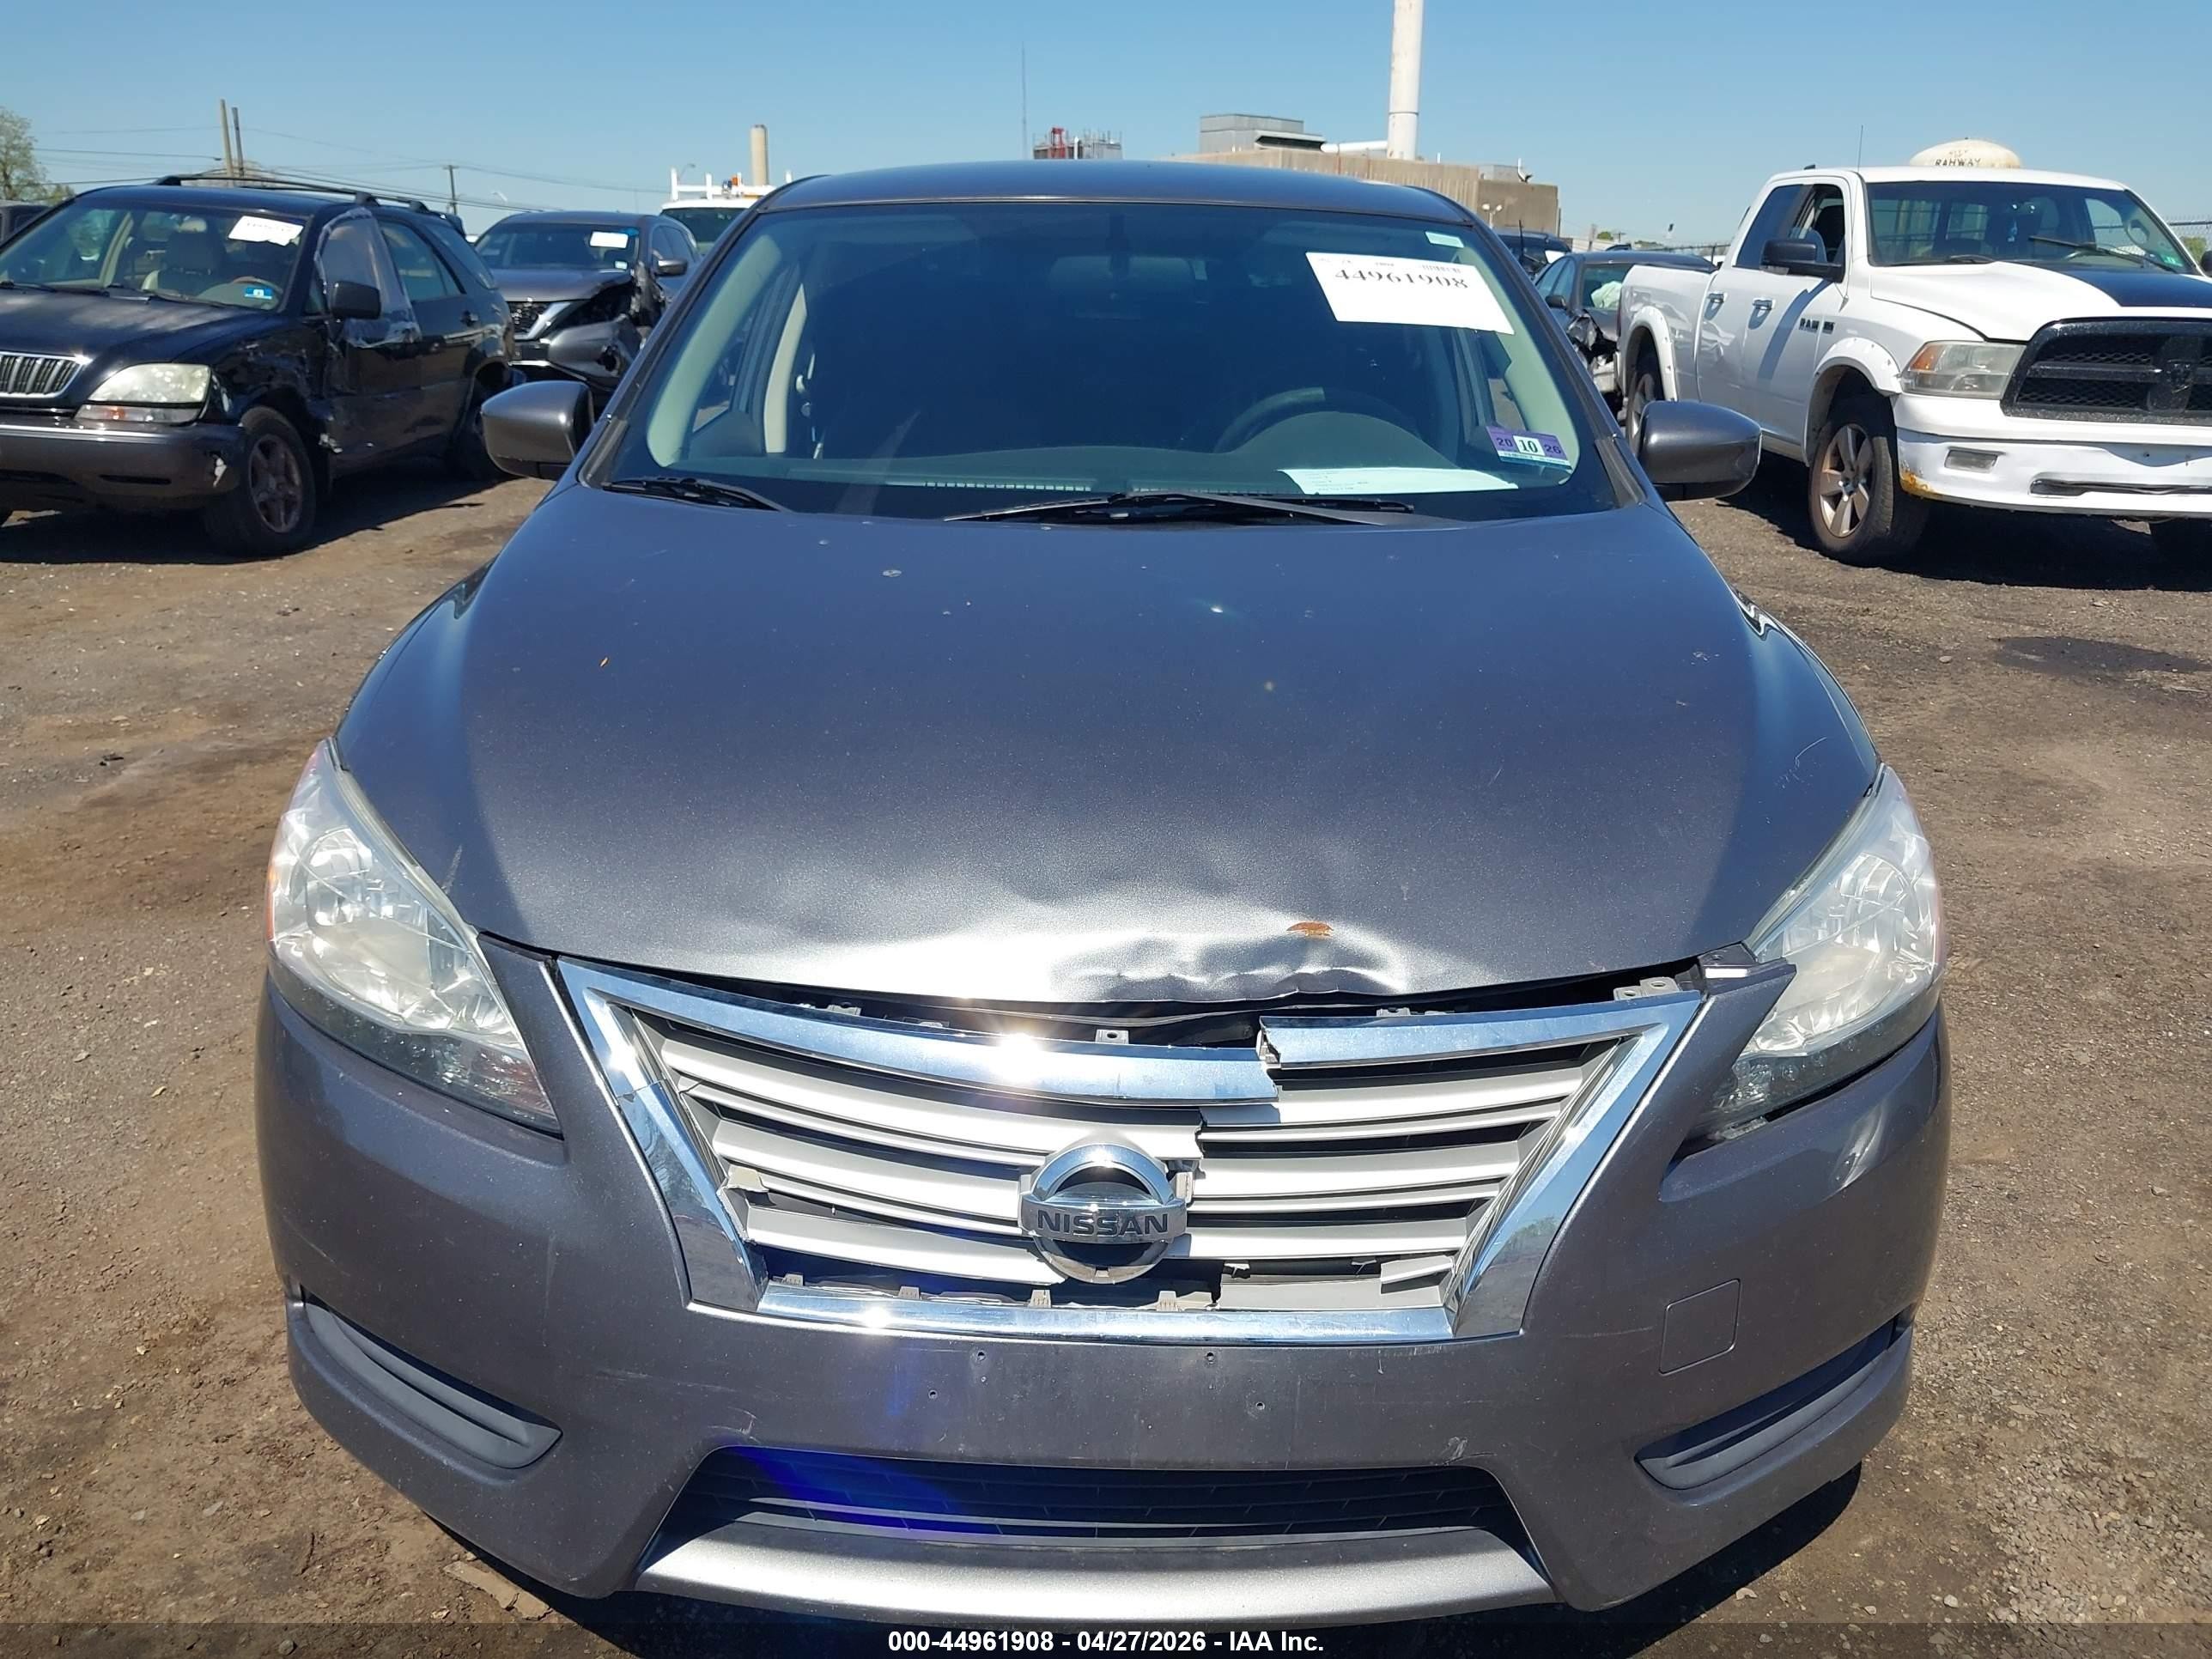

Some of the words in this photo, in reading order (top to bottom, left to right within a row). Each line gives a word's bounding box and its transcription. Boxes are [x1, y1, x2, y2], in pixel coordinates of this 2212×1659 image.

[1935, 158, 1981, 167] RAHWAY
[1334, 268, 1468, 289] 44961908
[1496, 437, 1513, 447] 20
[1519, 439, 1538, 453] 10
[1544, 444, 1561, 454] 26
[1037, 1209, 1168, 1236] NISSAN
